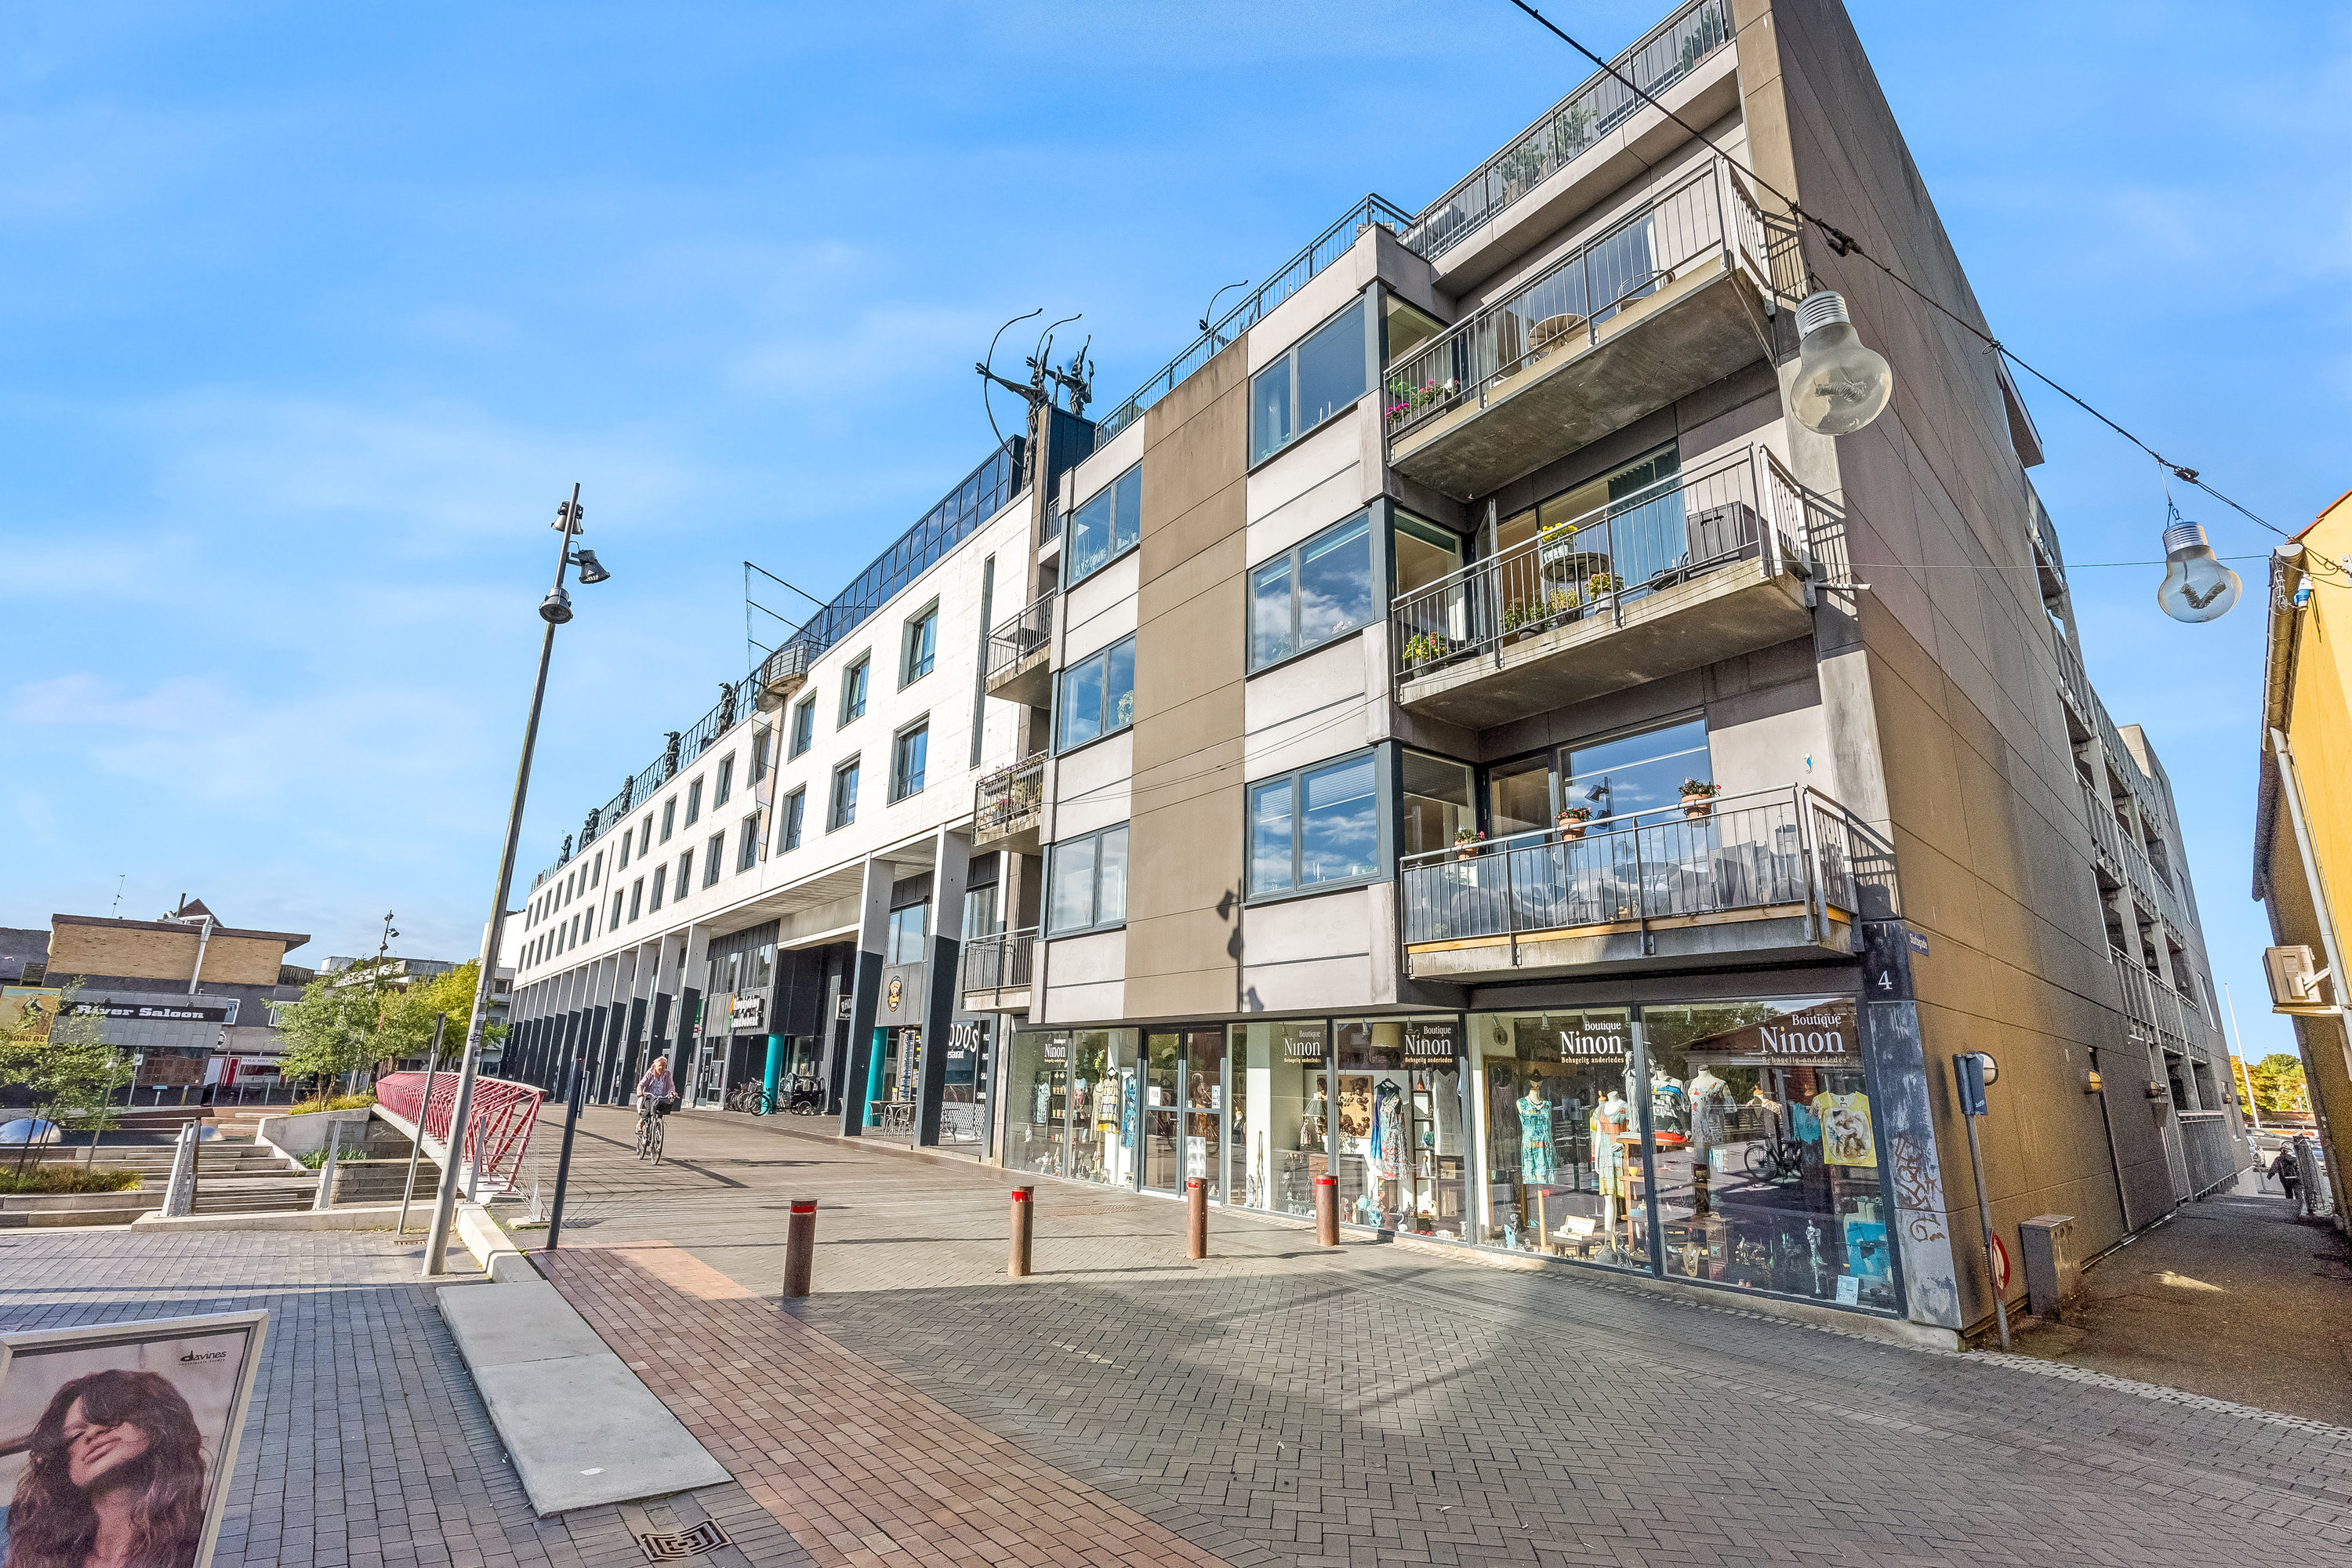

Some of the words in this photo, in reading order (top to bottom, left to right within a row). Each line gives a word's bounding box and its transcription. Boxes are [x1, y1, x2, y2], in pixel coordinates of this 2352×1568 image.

[1878, 970, 1893, 990] 4
[76, 1004, 134, 1016] River
[139, 1007, 205, 1018] Saloon
[840, 998, 852, 1012] RHO
[1584, 1021, 1621, 1033] Boutique
[1792, 1014, 1842, 1028] Boutique
[1299, 1030, 1321, 1040] Boutique
[1424, 1025, 1452, 1036] Boutique
[1283, 1037, 1321, 1056] Ninon
[1404, 1035, 1452, 1055] Ninon
[1559, 1030, 1624, 1054] Ninon
[1759, 1026, 1846, 1053] Ninon
[1044, 1043, 1065, 1058] Ninon
[1762, 1056, 1799, 1065] Behagelig
[1802, 1055, 1847, 1064] anderledes
[180, 1350, 227, 1362] davines
